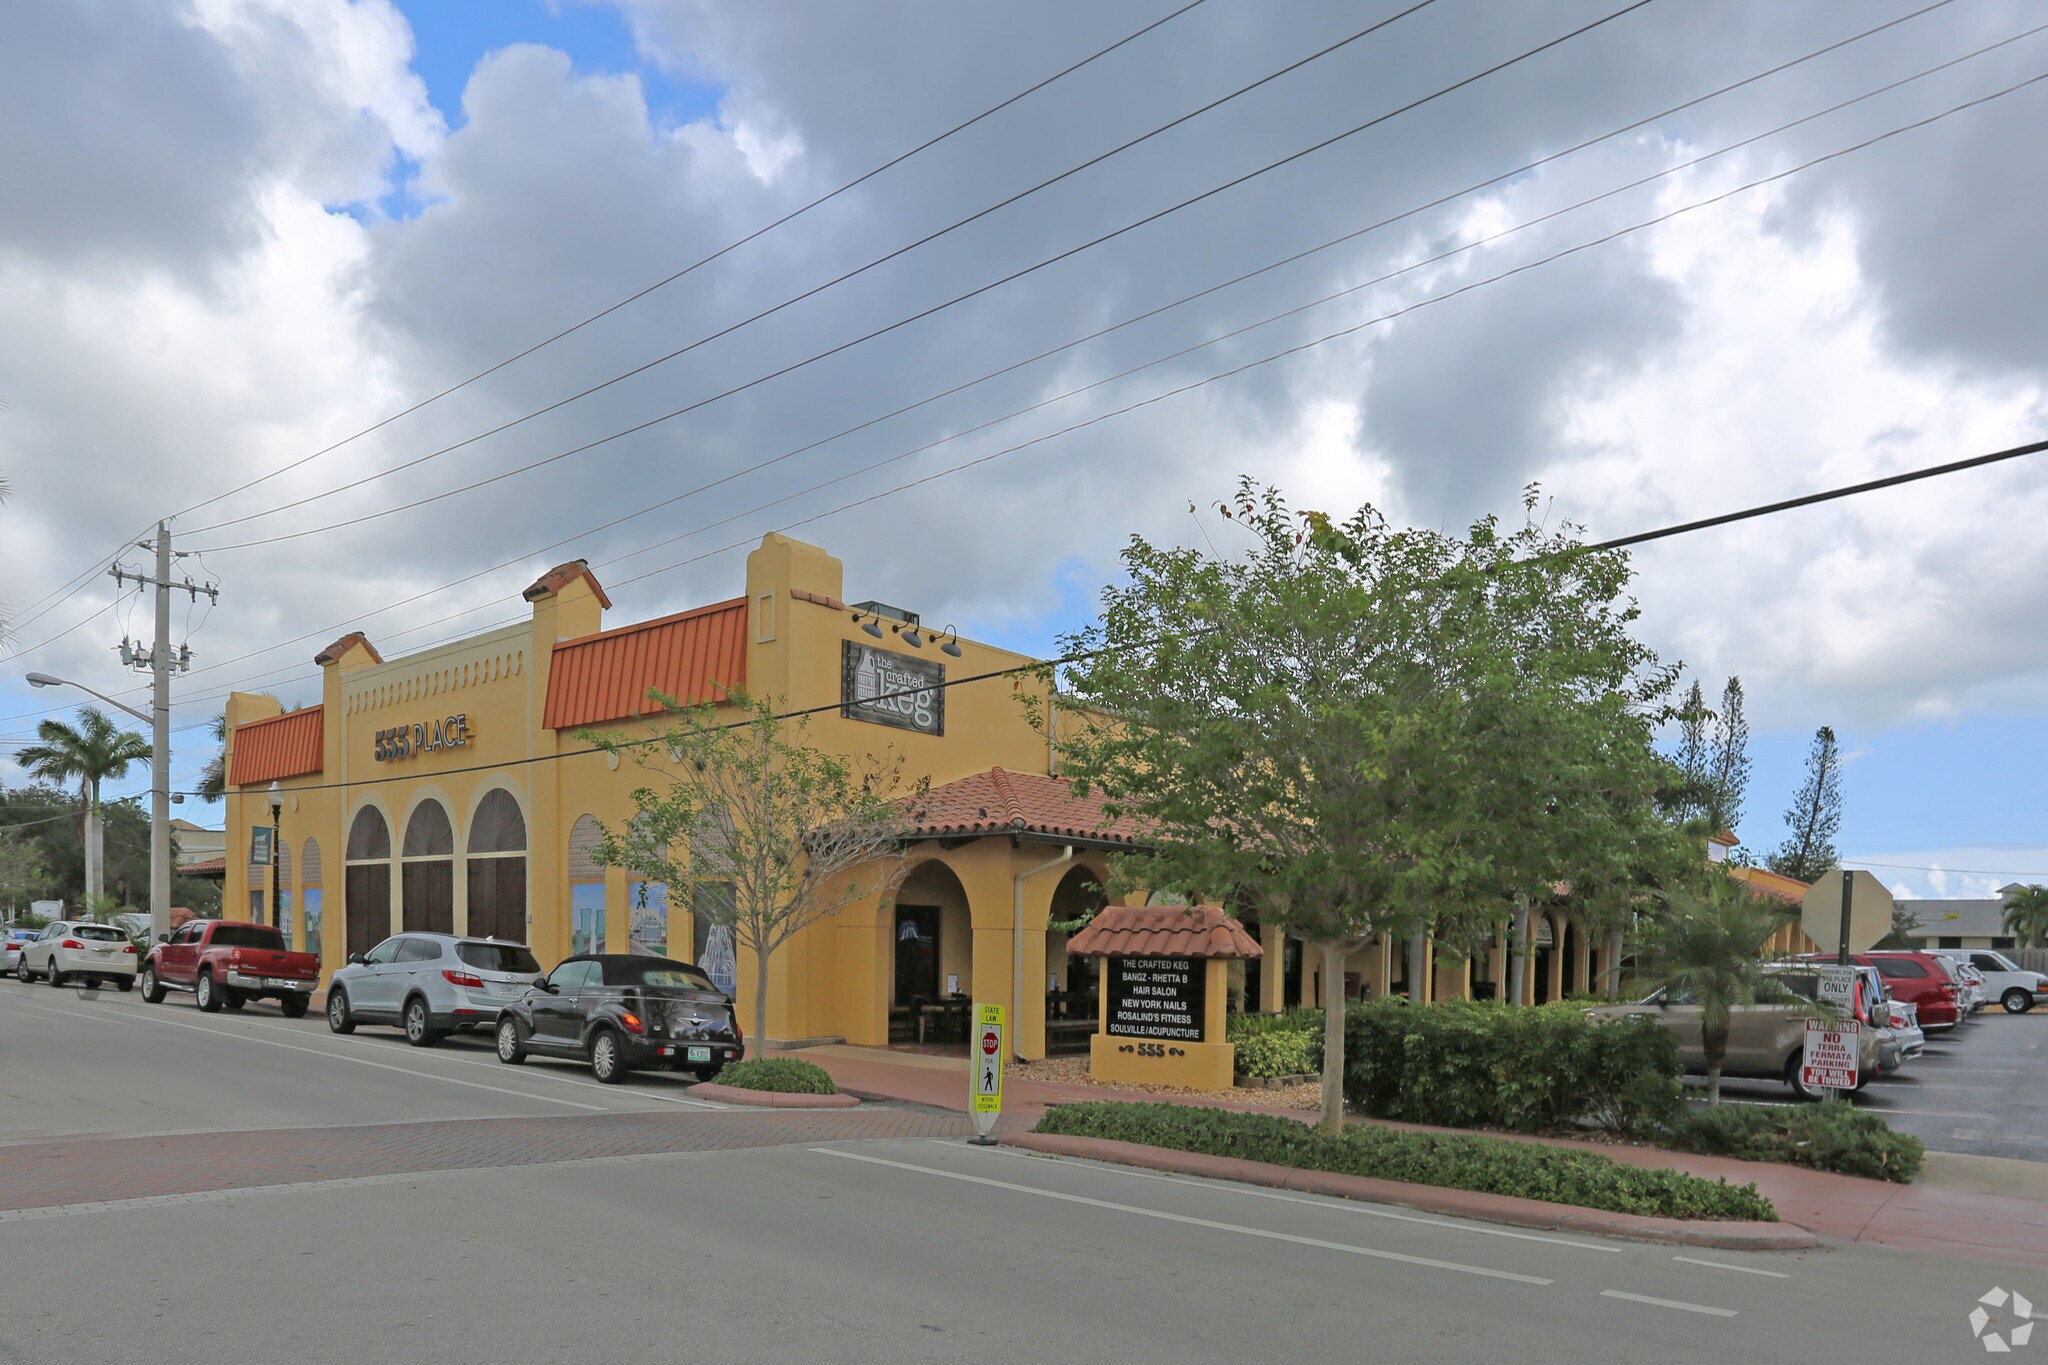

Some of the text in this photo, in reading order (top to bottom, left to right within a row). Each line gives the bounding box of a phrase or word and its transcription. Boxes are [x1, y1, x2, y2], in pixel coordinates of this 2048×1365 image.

[877, 656, 892, 669] the
[886, 671, 924, 688] crafted
[876, 668, 934, 727] keg
[375, 714, 466, 761] 555 PLACE
[1122, 959, 1189, 970] THE CRAFTED KEG
[1122, 972, 1147, 982] BANGZ
[1152, 973, 1180, 983] RHETTA
[1182, 974, 1188, 983] B
[1834, 975, 1852, 983] PLACE
[1133, 986, 1177, 996] HAIR SALON
[1823, 982, 1849, 993] ONLY
[984, 1006, 1000, 1015] STATE
[1122, 999, 1187, 1011] NEW YORK NAILS
[1117, 1011, 1192, 1024] ROSALIND'S FITNESS
[1823, 1032, 1841, 1043] NO
[983, 1039, 998, 1049] STOP
[1137, 1042, 1165, 1057] 555
[1817, 1043, 1846, 1052] TERRA
[1810, 1050, 1852, 1061] FERMATA
[1811, 1058, 1850, 1069] PARKING
[1811, 1067, 1849, 1079] YOU WILL
[1807, 1075, 1851, 1086] BE TOWED
